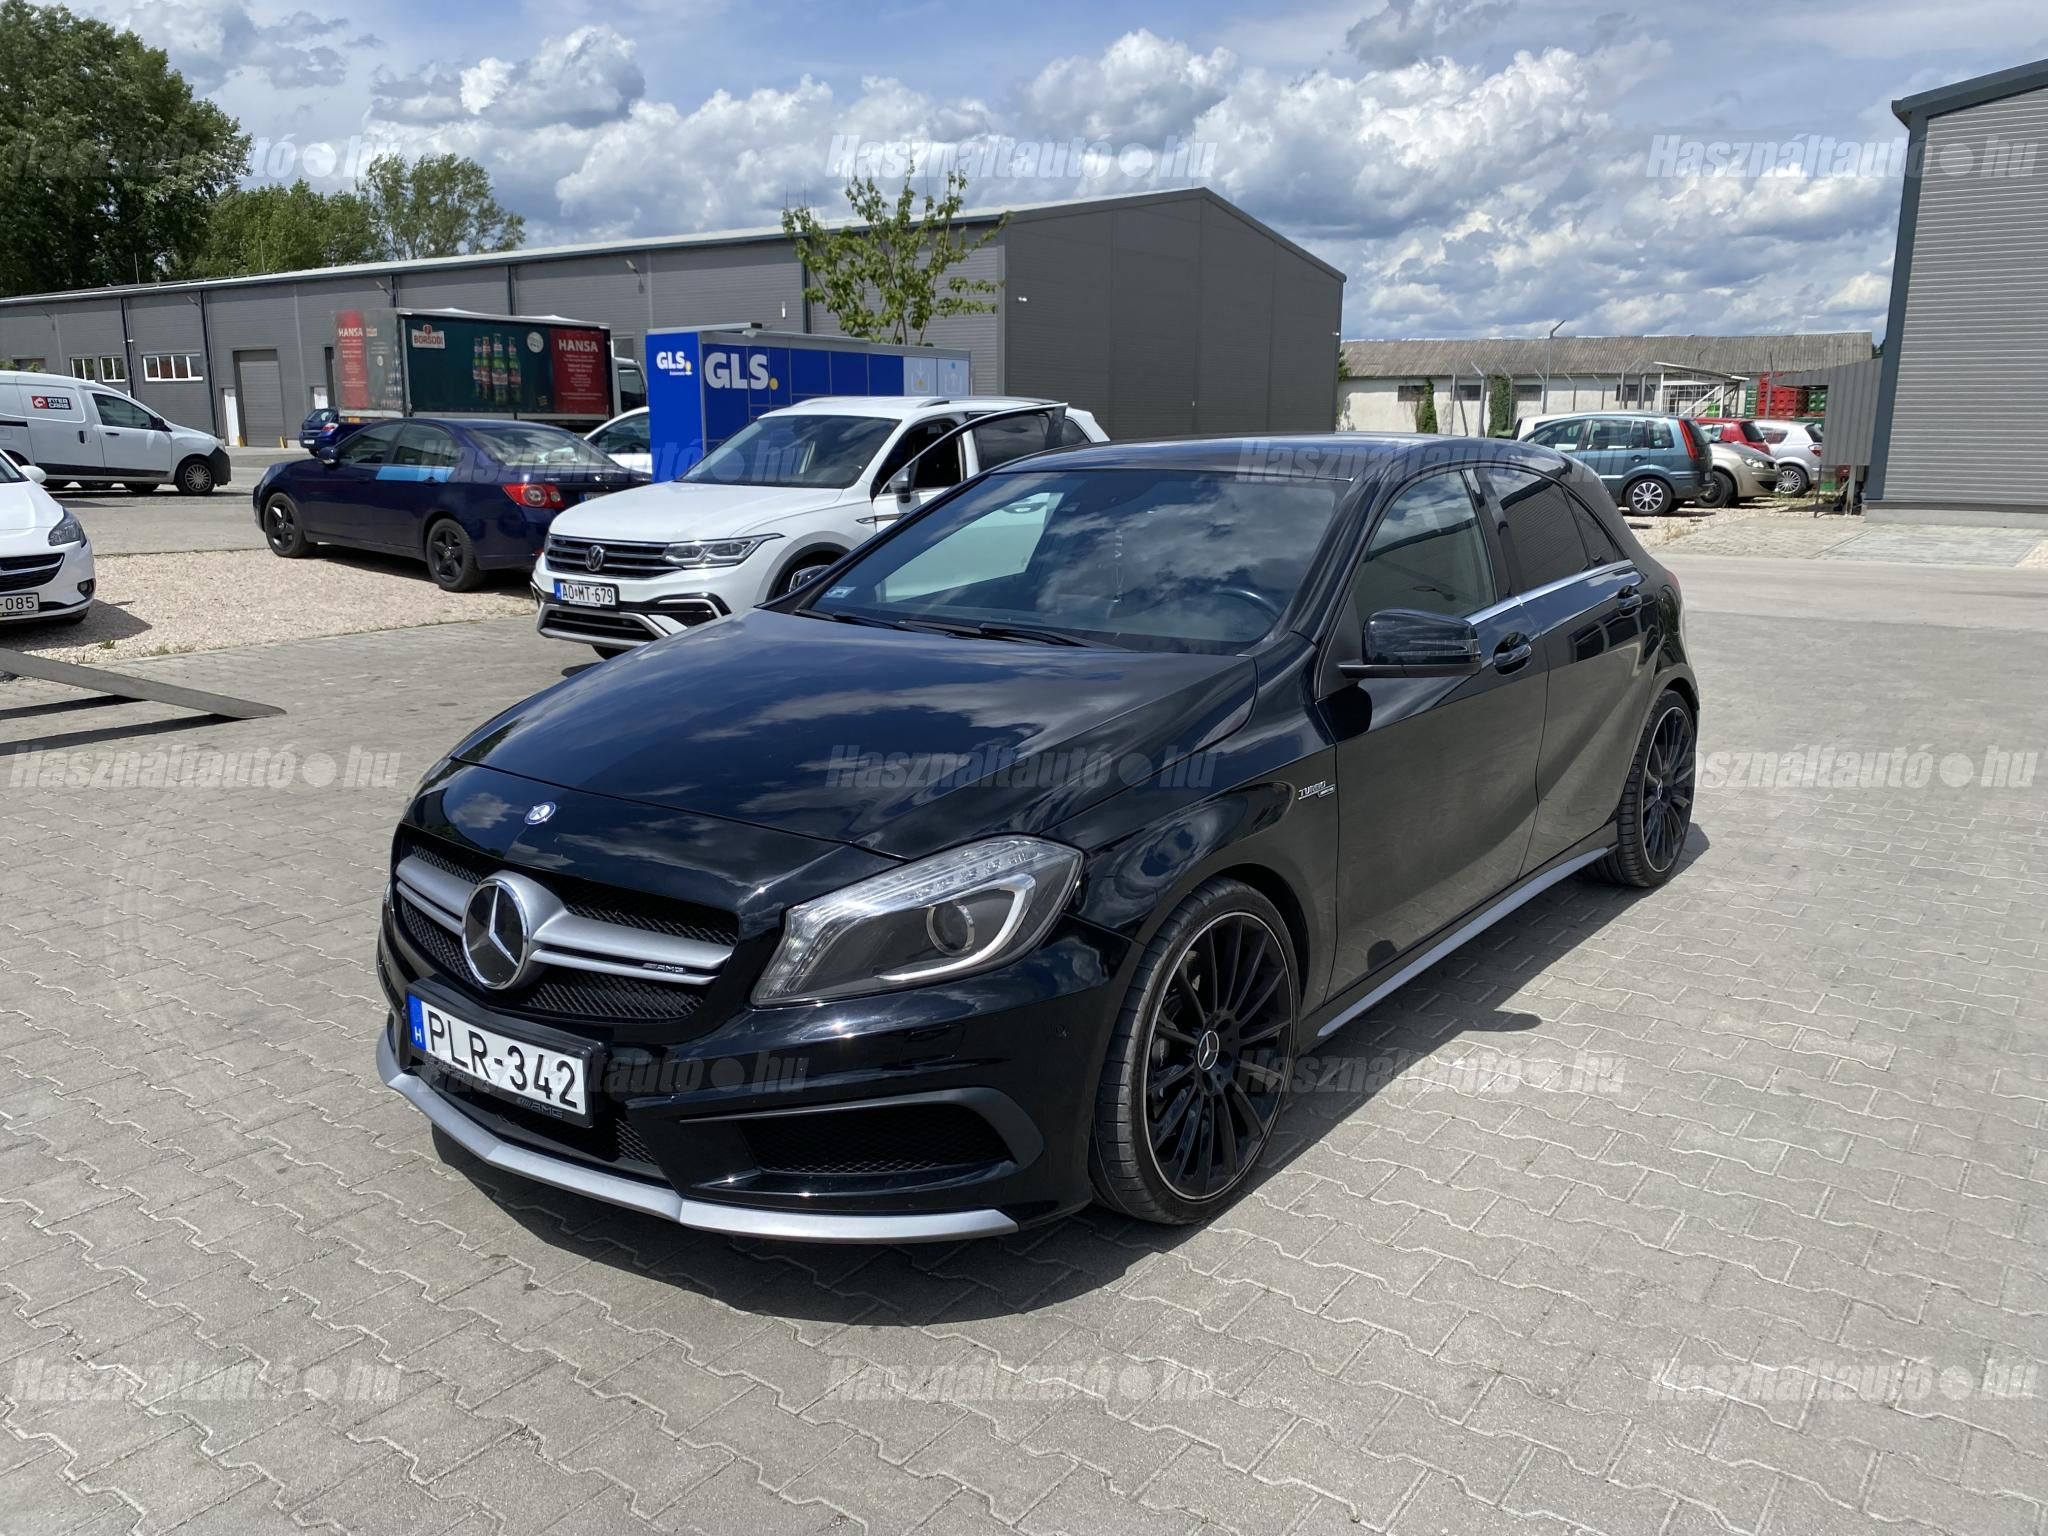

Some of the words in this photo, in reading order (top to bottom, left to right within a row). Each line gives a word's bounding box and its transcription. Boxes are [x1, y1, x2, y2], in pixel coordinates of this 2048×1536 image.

[338, 327, 363, 337] HANSA
[558, 339, 599, 352] HANSA
[414, 1026, 423, 1043] H
[427, 1010, 578, 1109] PLR-342
[529, 1101, 563, 1120] AMG
